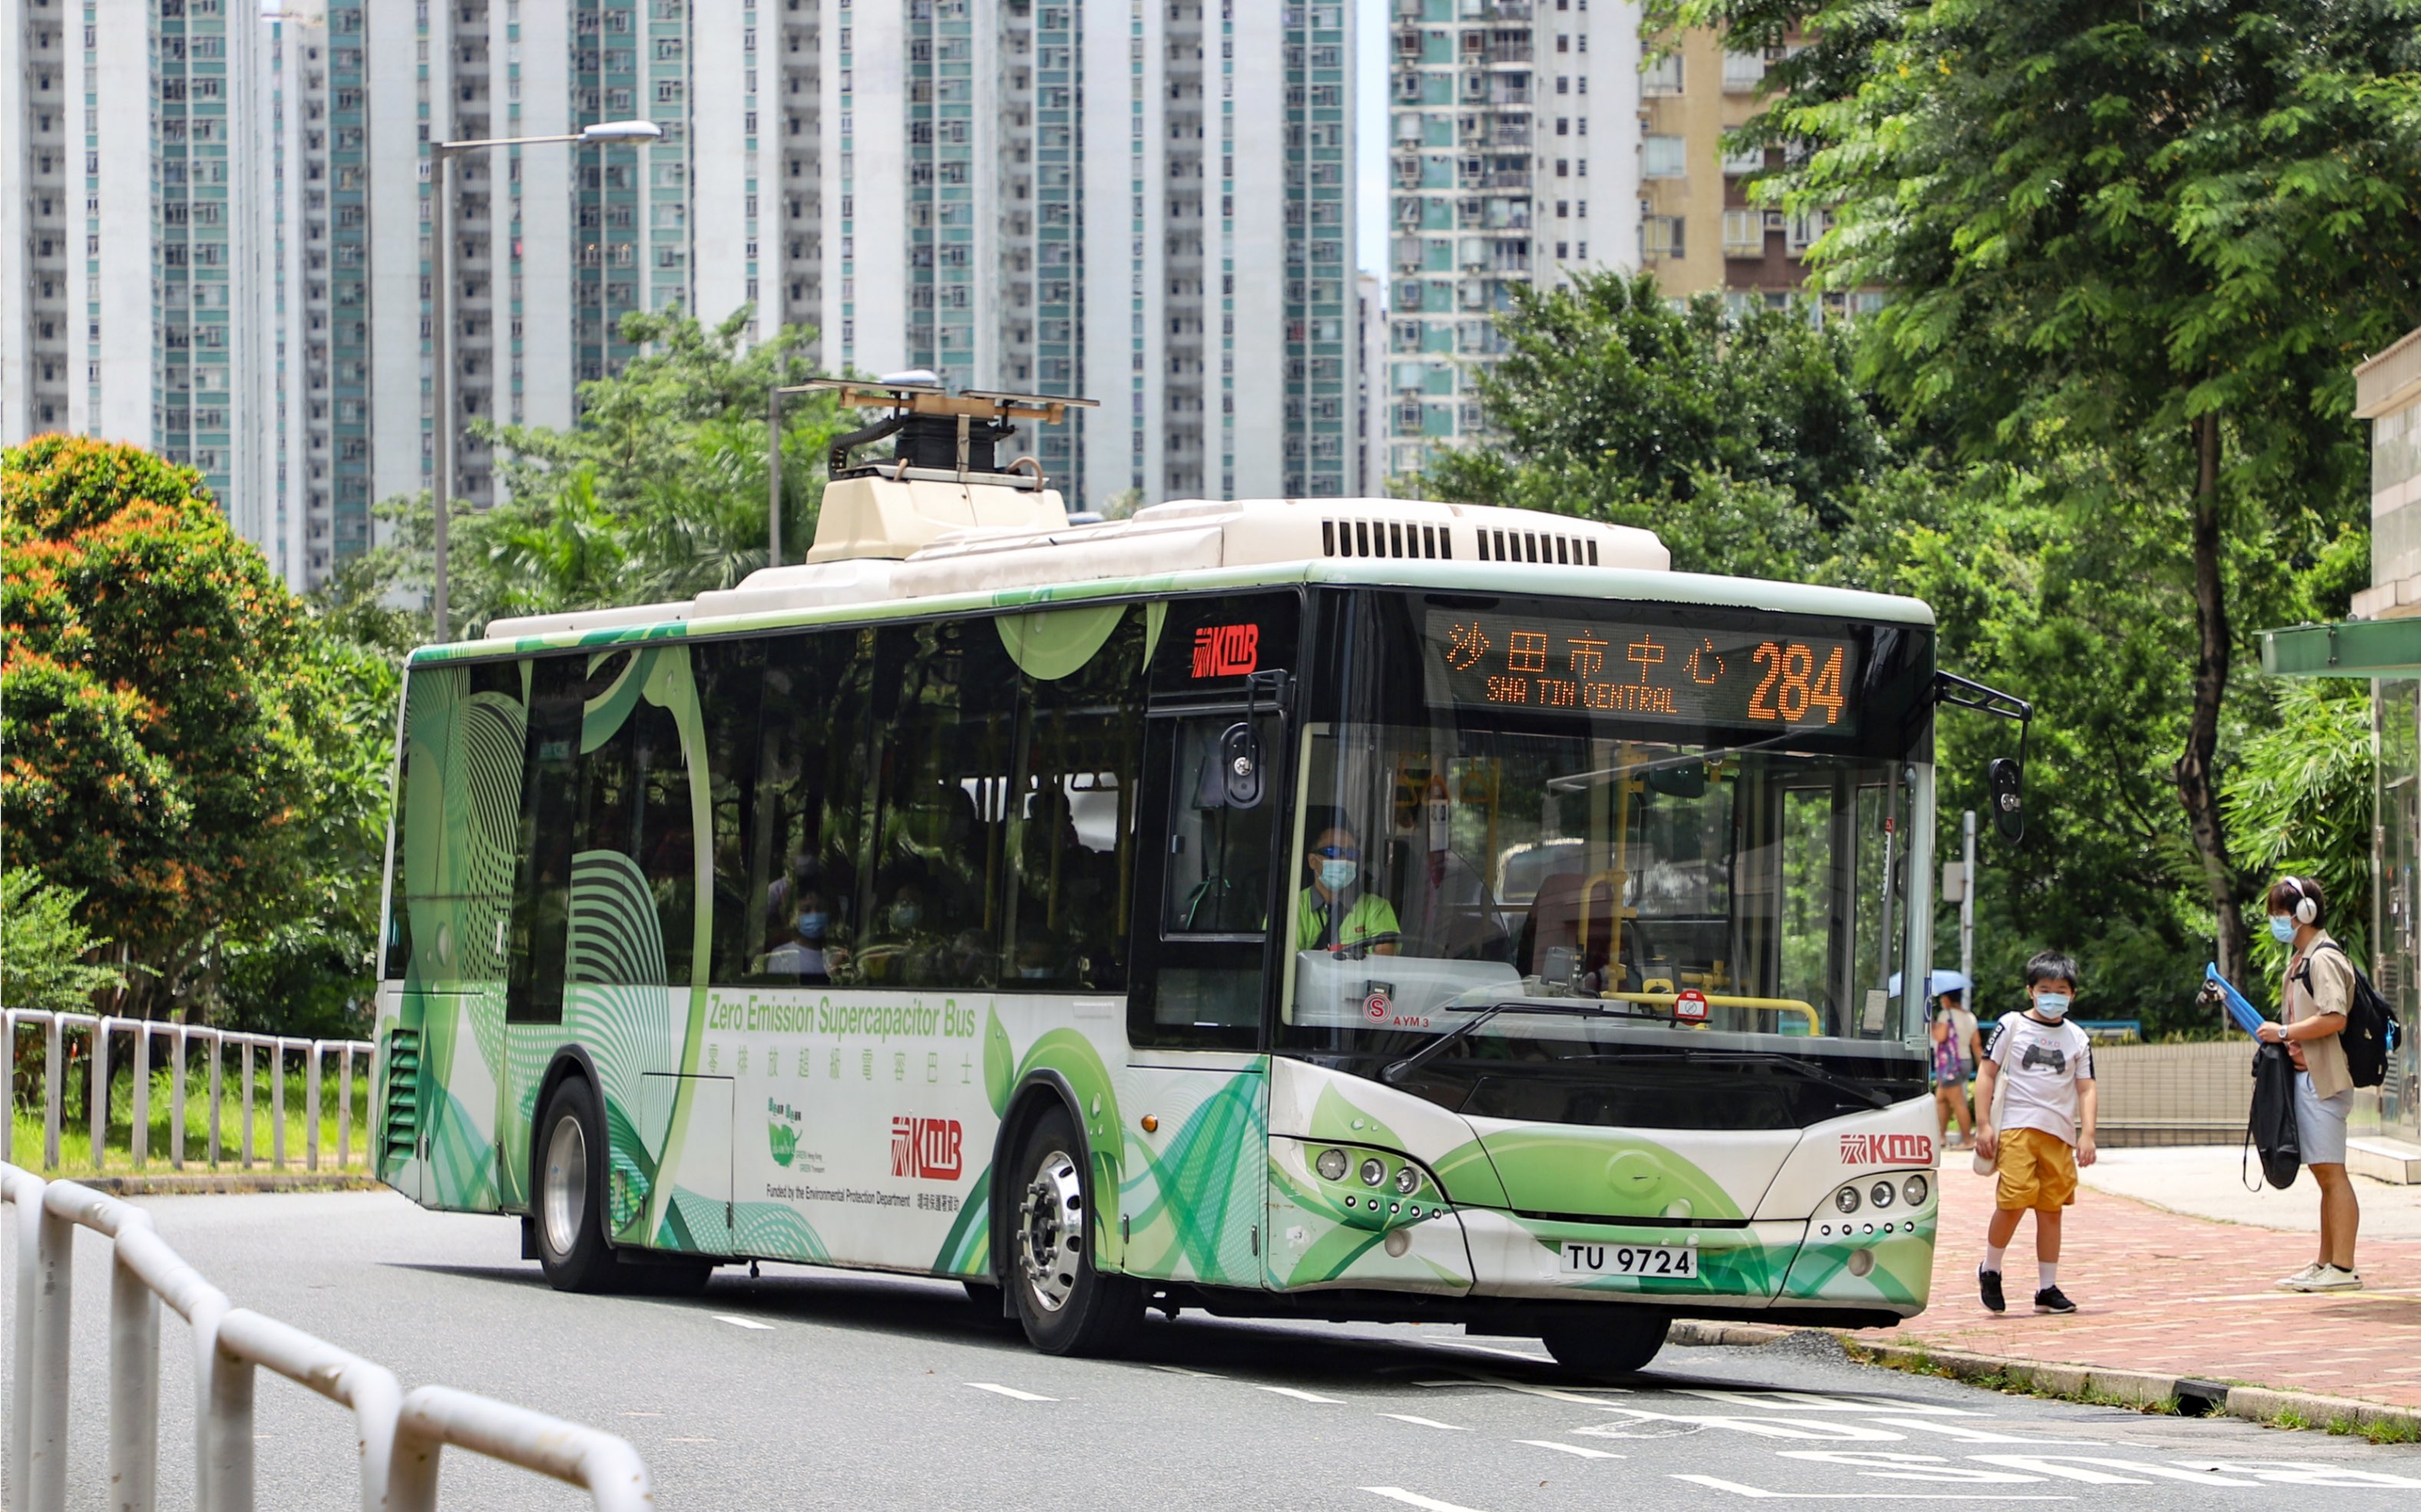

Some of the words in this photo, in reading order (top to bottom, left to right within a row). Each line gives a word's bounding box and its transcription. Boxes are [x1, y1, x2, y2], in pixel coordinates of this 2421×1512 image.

[1209, 624, 1258, 677] KMB
[1447, 621, 1725, 685] 沙田市中心
[1486, 676, 1527, 704] SHA
[1536, 678, 1575, 706] TIN
[1583, 683, 1678, 713] CENTRAL
[1748, 641, 1844, 724] 284
[709, 994, 743, 1031] Zero
[746, 995, 814, 1033] Emission
[819, 996, 940, 1043] Supercapacitor
[944, 999, 975, 1037] Bus
[1371, 999, 1384, 1017] S
[912, 1117, 962, 1180] KMB
[1870, 1134, 1933, 1164] KMB
[766, 1183, 787, 1199] Funded
[788, 1185, 795, 1201] by
[796, 1186, 805, 1199] the
[806, 1186, 845, 1203] Environmental
[846, 1189, 875, 1204] Protection
[877, 1191, 911, 1208] Department
[1568, 1245, 1603, 1270] TU
[1617, 1248, 1689, 1275] 9724
